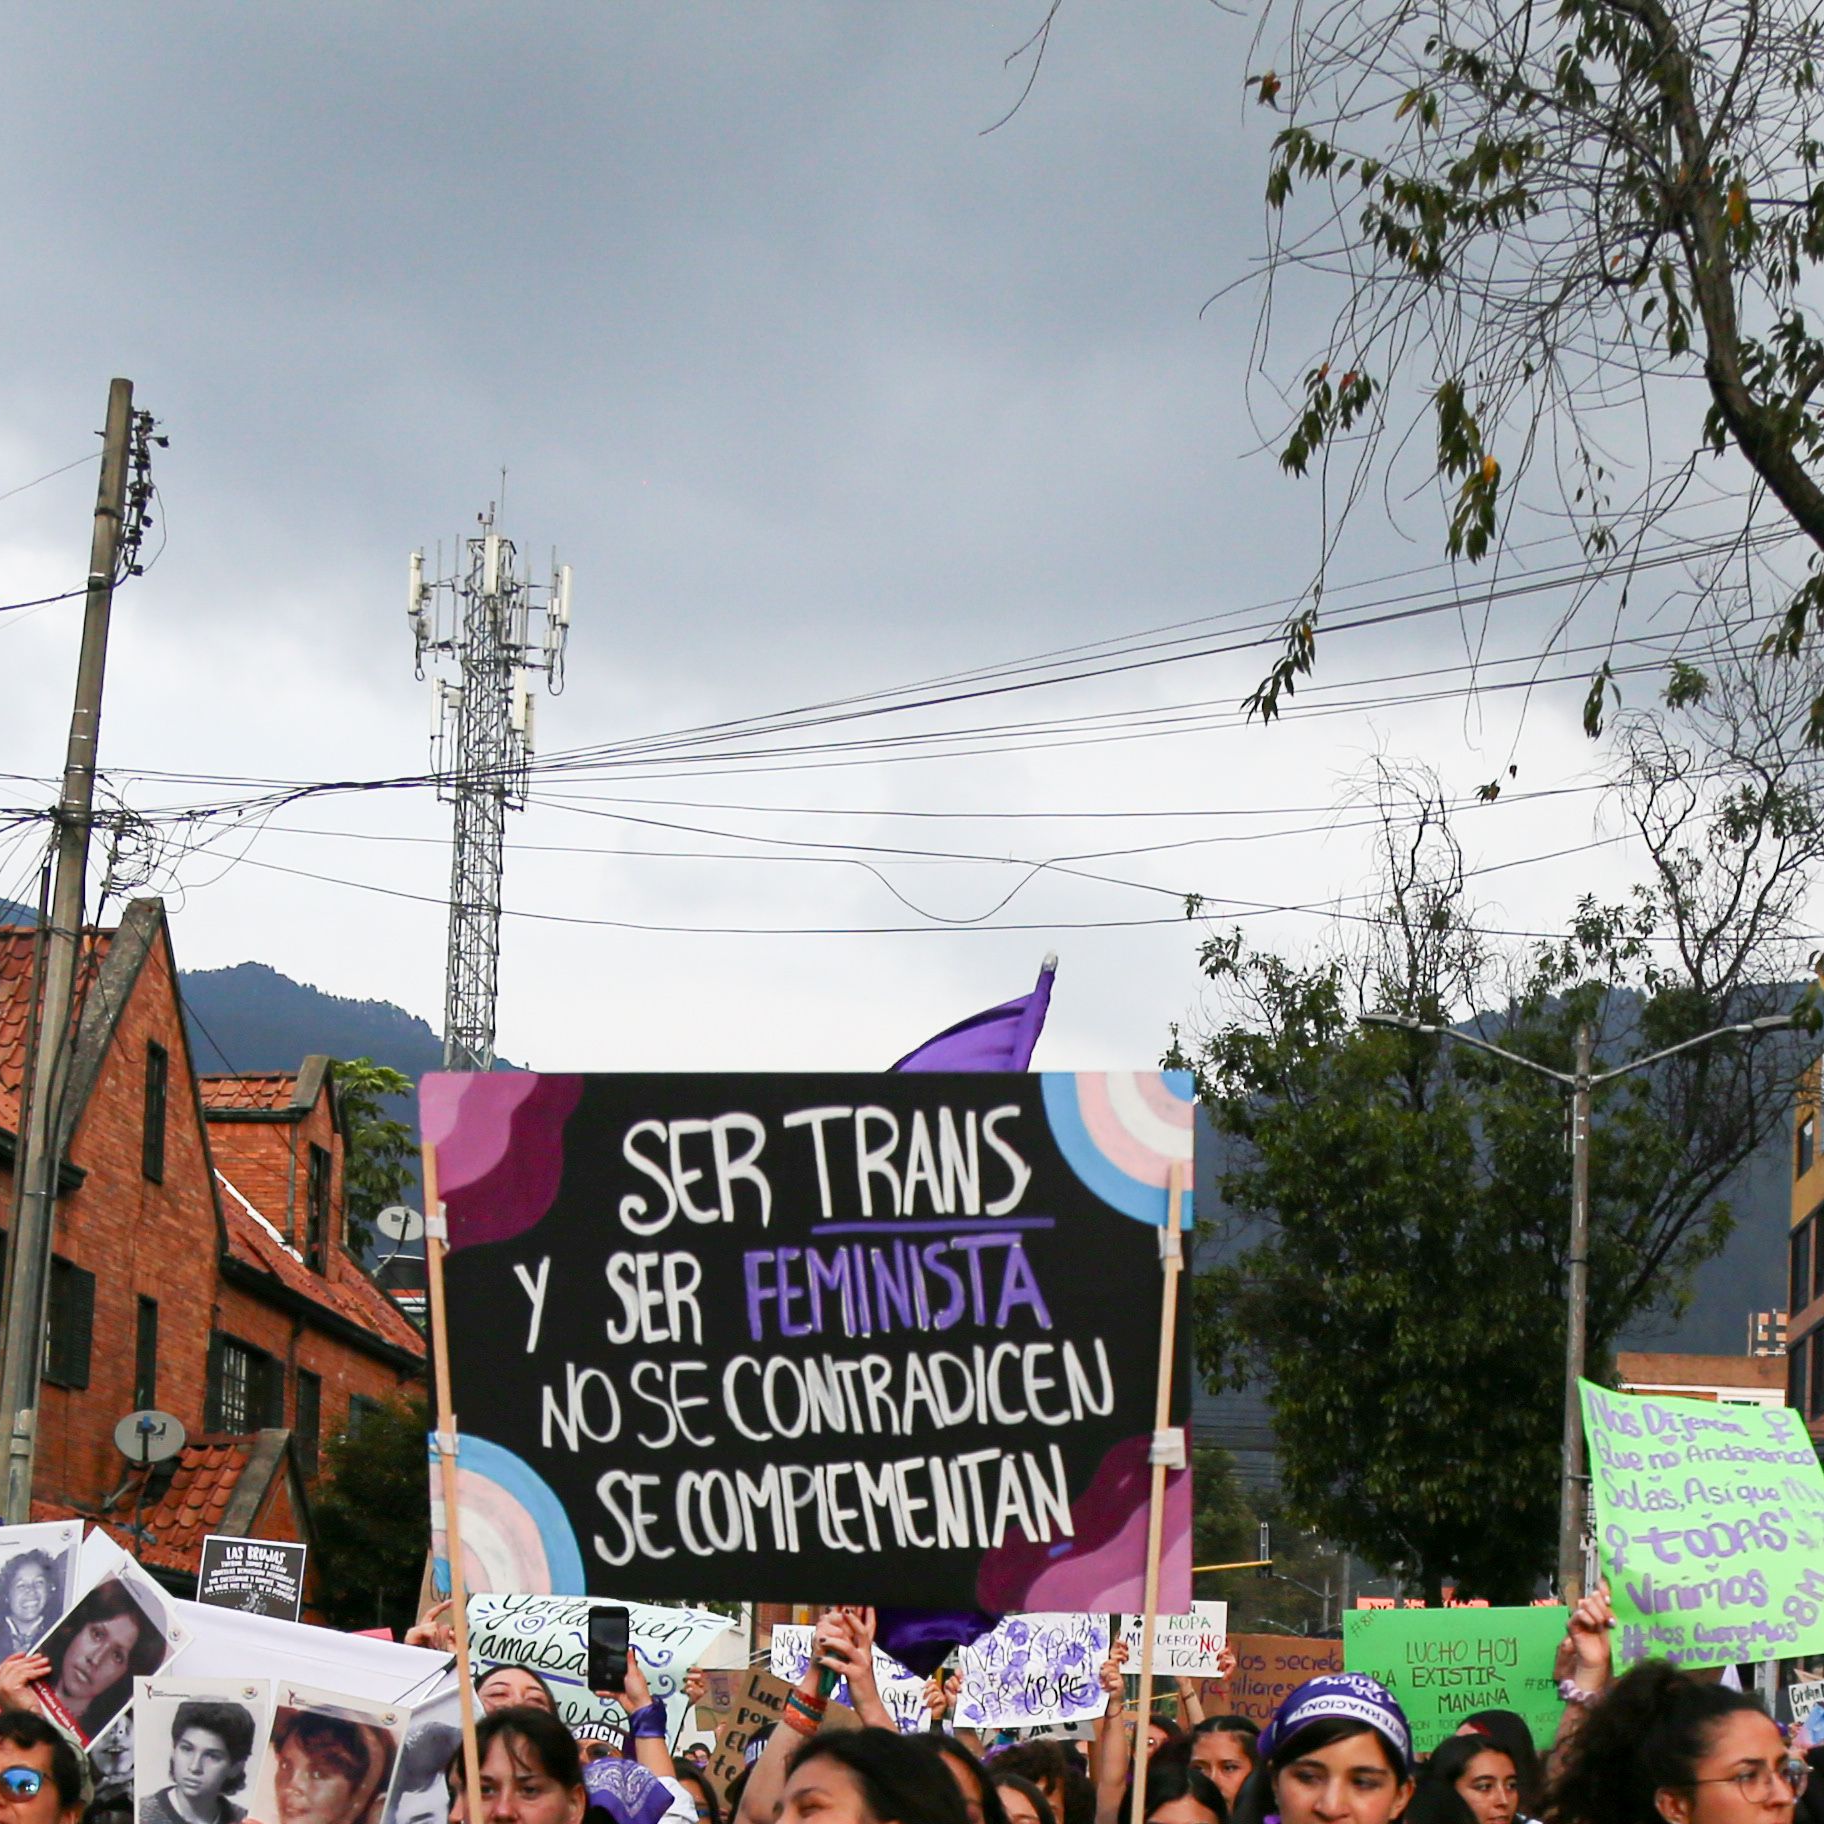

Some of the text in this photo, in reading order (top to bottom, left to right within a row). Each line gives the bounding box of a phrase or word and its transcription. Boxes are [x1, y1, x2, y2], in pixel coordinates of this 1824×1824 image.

[619, 1105, 1031, 1236] SER TRANS
[513, 1232, 1052, 1353] Y SER FEMINISTA
[541, 1339, 1113, 1452] NO SE CONTRADICEN
[594, 1444, 1074, 1565] SE COMPLEMENTAN
[226, 1545, 287, 1566] LAS BRUJAS
[1168, 1615, 1211, 1630] ROPA
[1155, 1633, 1198, 1647] UERPO
[1199, 1634, 1223, 1654] NO
[1406, 1640, 1468, 1665] LUCHO
[1169, 1648, 1211, 1669] TOCA
[1412, 1665, 1507, 1688] EXISTIR
